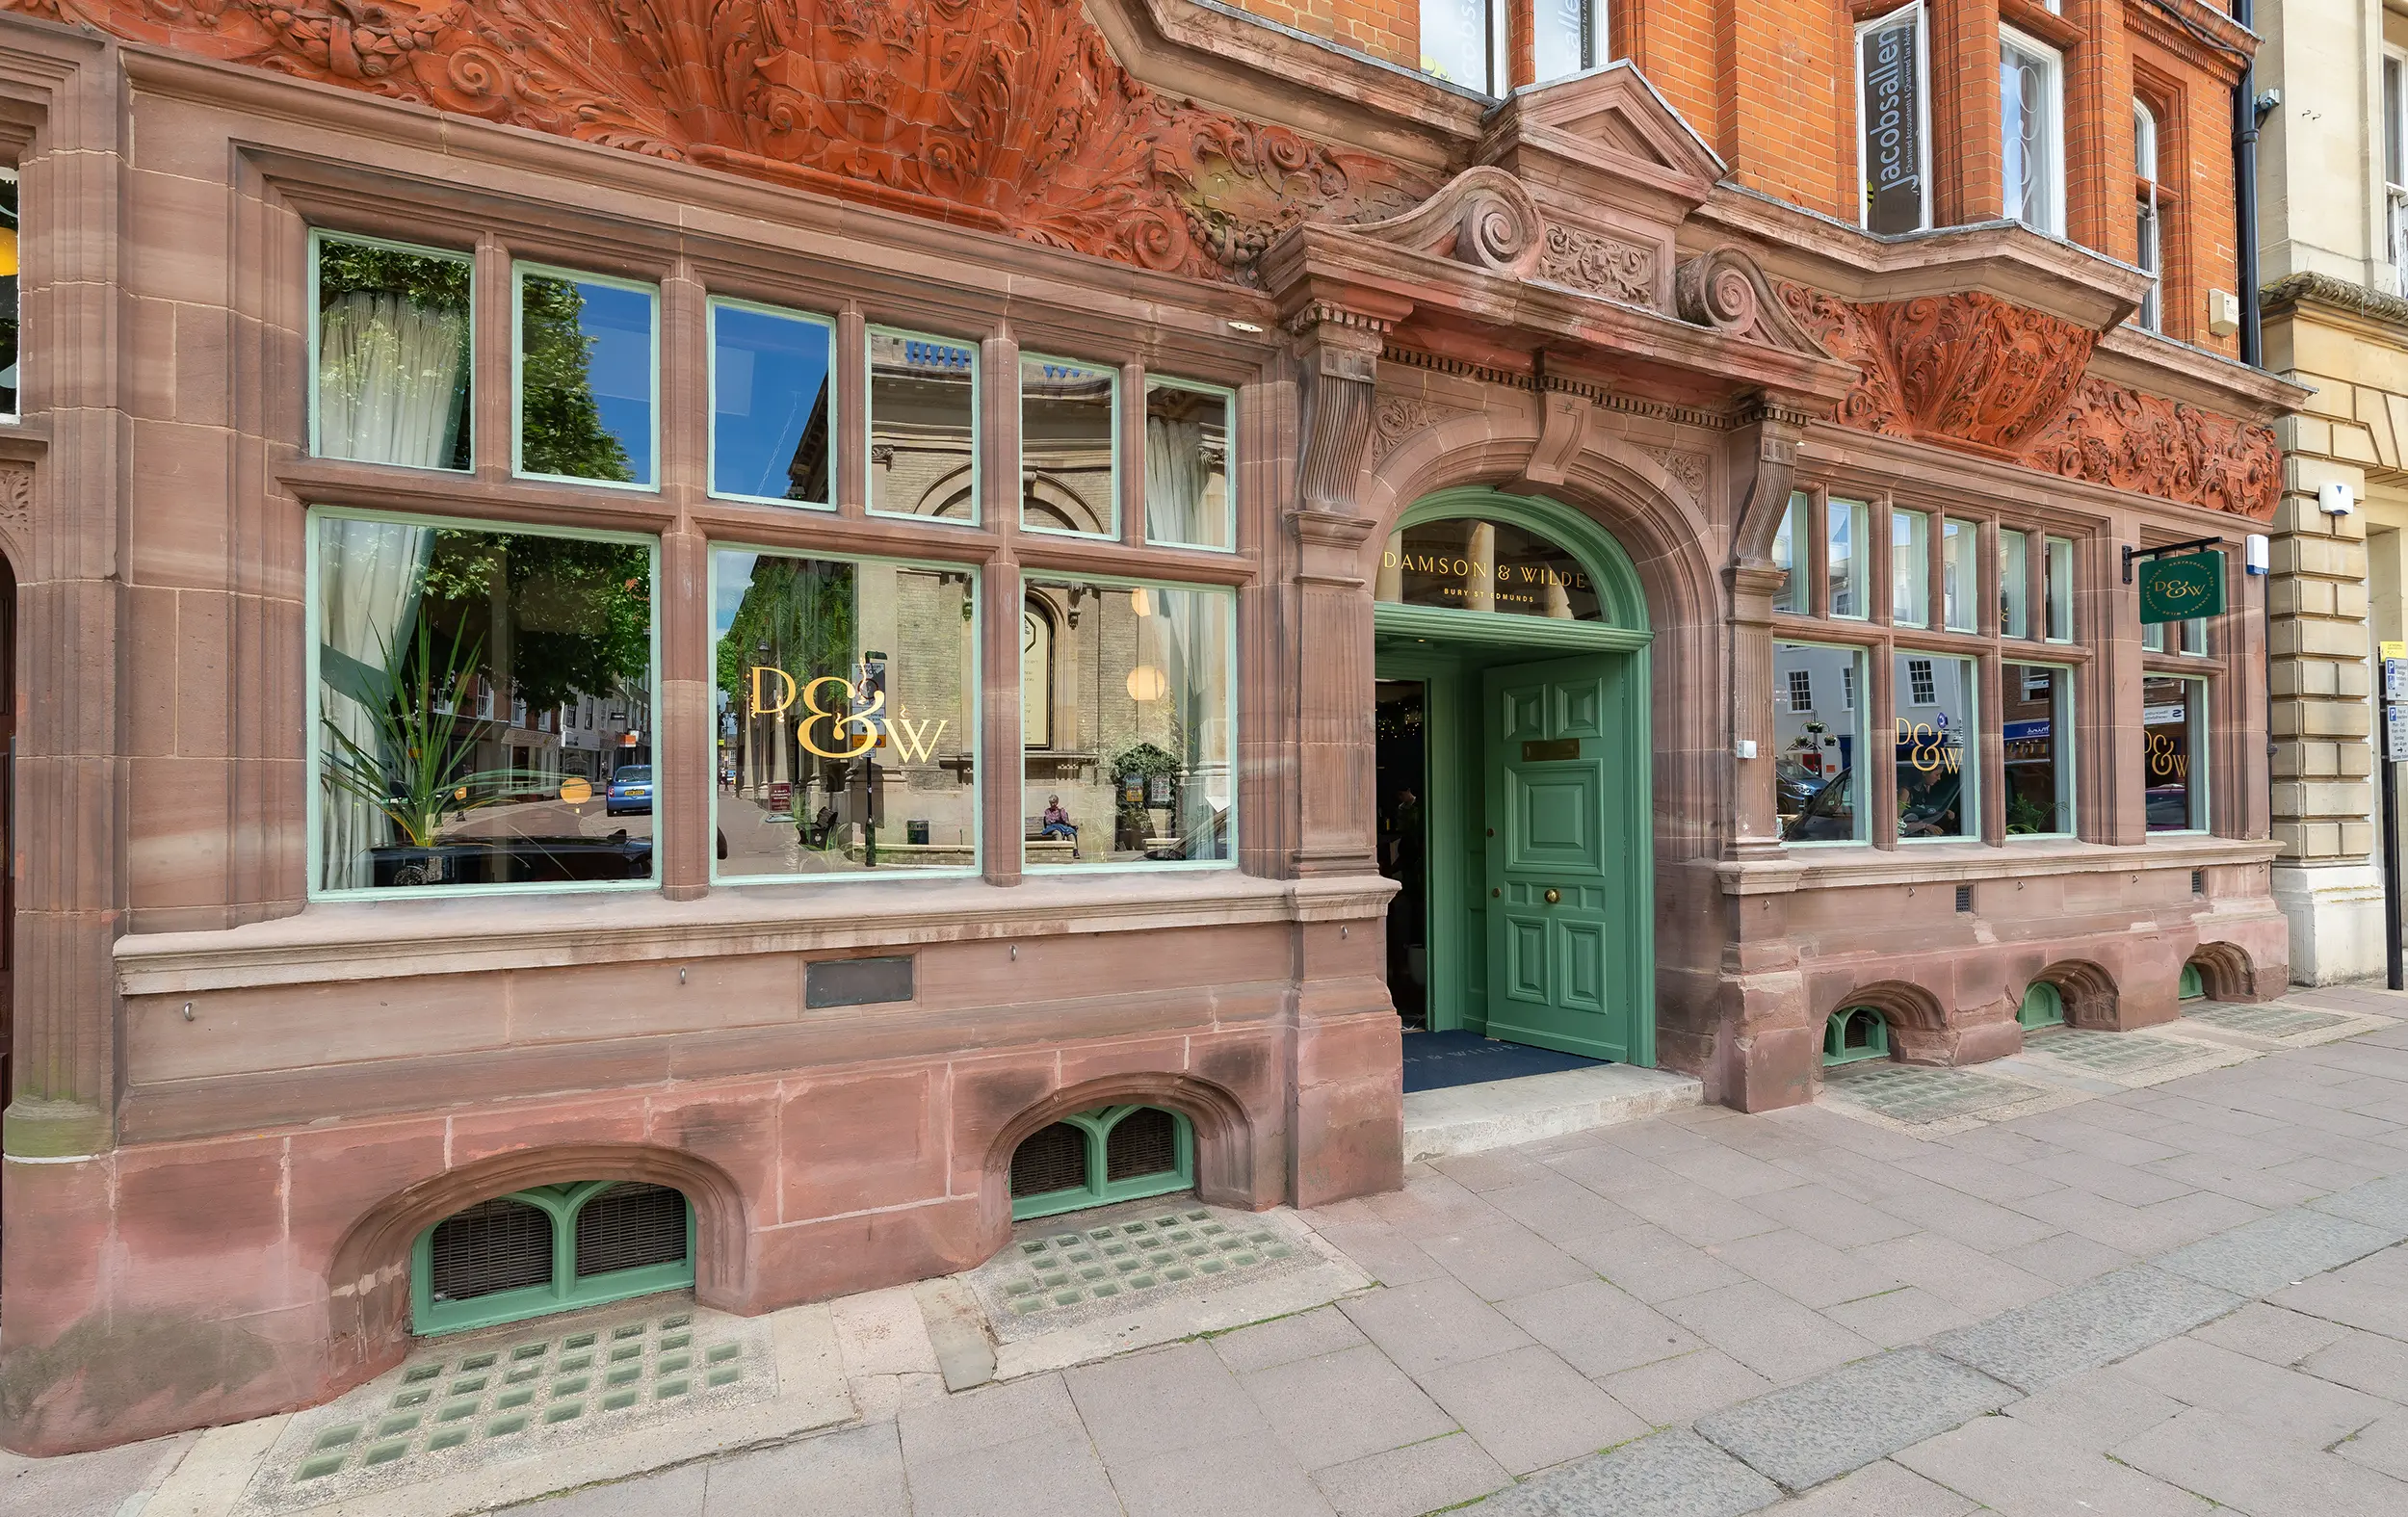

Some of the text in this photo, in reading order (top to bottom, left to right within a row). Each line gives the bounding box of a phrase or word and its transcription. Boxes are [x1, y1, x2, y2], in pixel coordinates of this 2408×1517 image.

[1903, 47, 1912, 60] Tax
[1903, 60, 1912, 92] Chartered
[1869, 26, 1920, 192] jacobsallen
[1904, 99, 1913, 140] Accountants
[1905, 140, 1914, 173] Chartered
[1383, 551, 1585, 588] DAMSON & WILDE
[1444, 588, 1469, 597] BURY
[1490, 592, 1534, 603] EDMUNDS
[2155, 580, 2207, 599] D&W
[750, 667, 949, 764] D&W
[1896, 717, 1964, 774] D&W
[1446, 1045, 1519, 1057] WILDE
